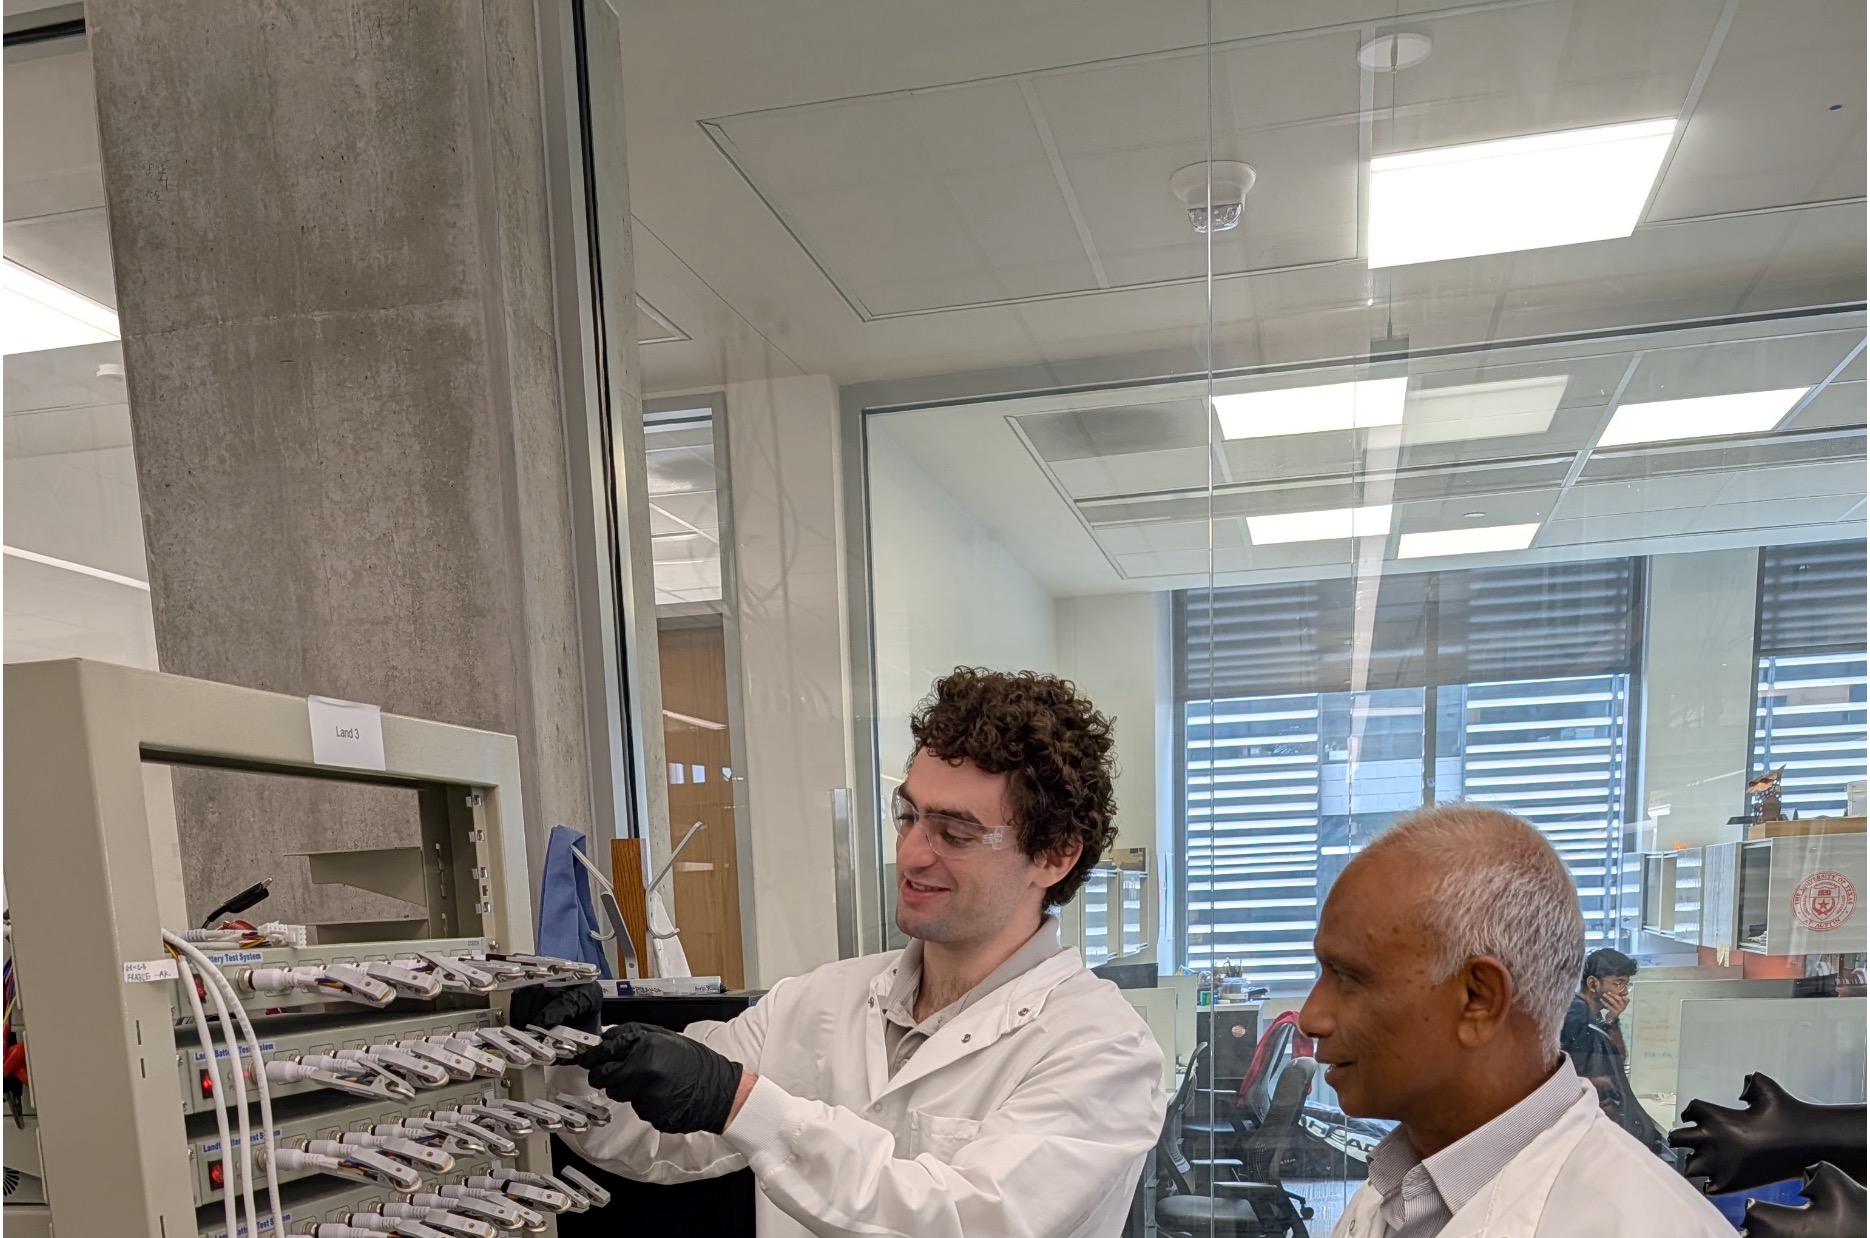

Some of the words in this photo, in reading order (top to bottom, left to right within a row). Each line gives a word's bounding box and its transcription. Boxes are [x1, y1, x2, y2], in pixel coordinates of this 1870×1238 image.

[335, 726, 354, 739] Land
[354, 728, 360, 740] 3
[225, 953, 239, 962] Test
[239, 951, 262, 961] System
[256, 1219, 270, 1229] Test
